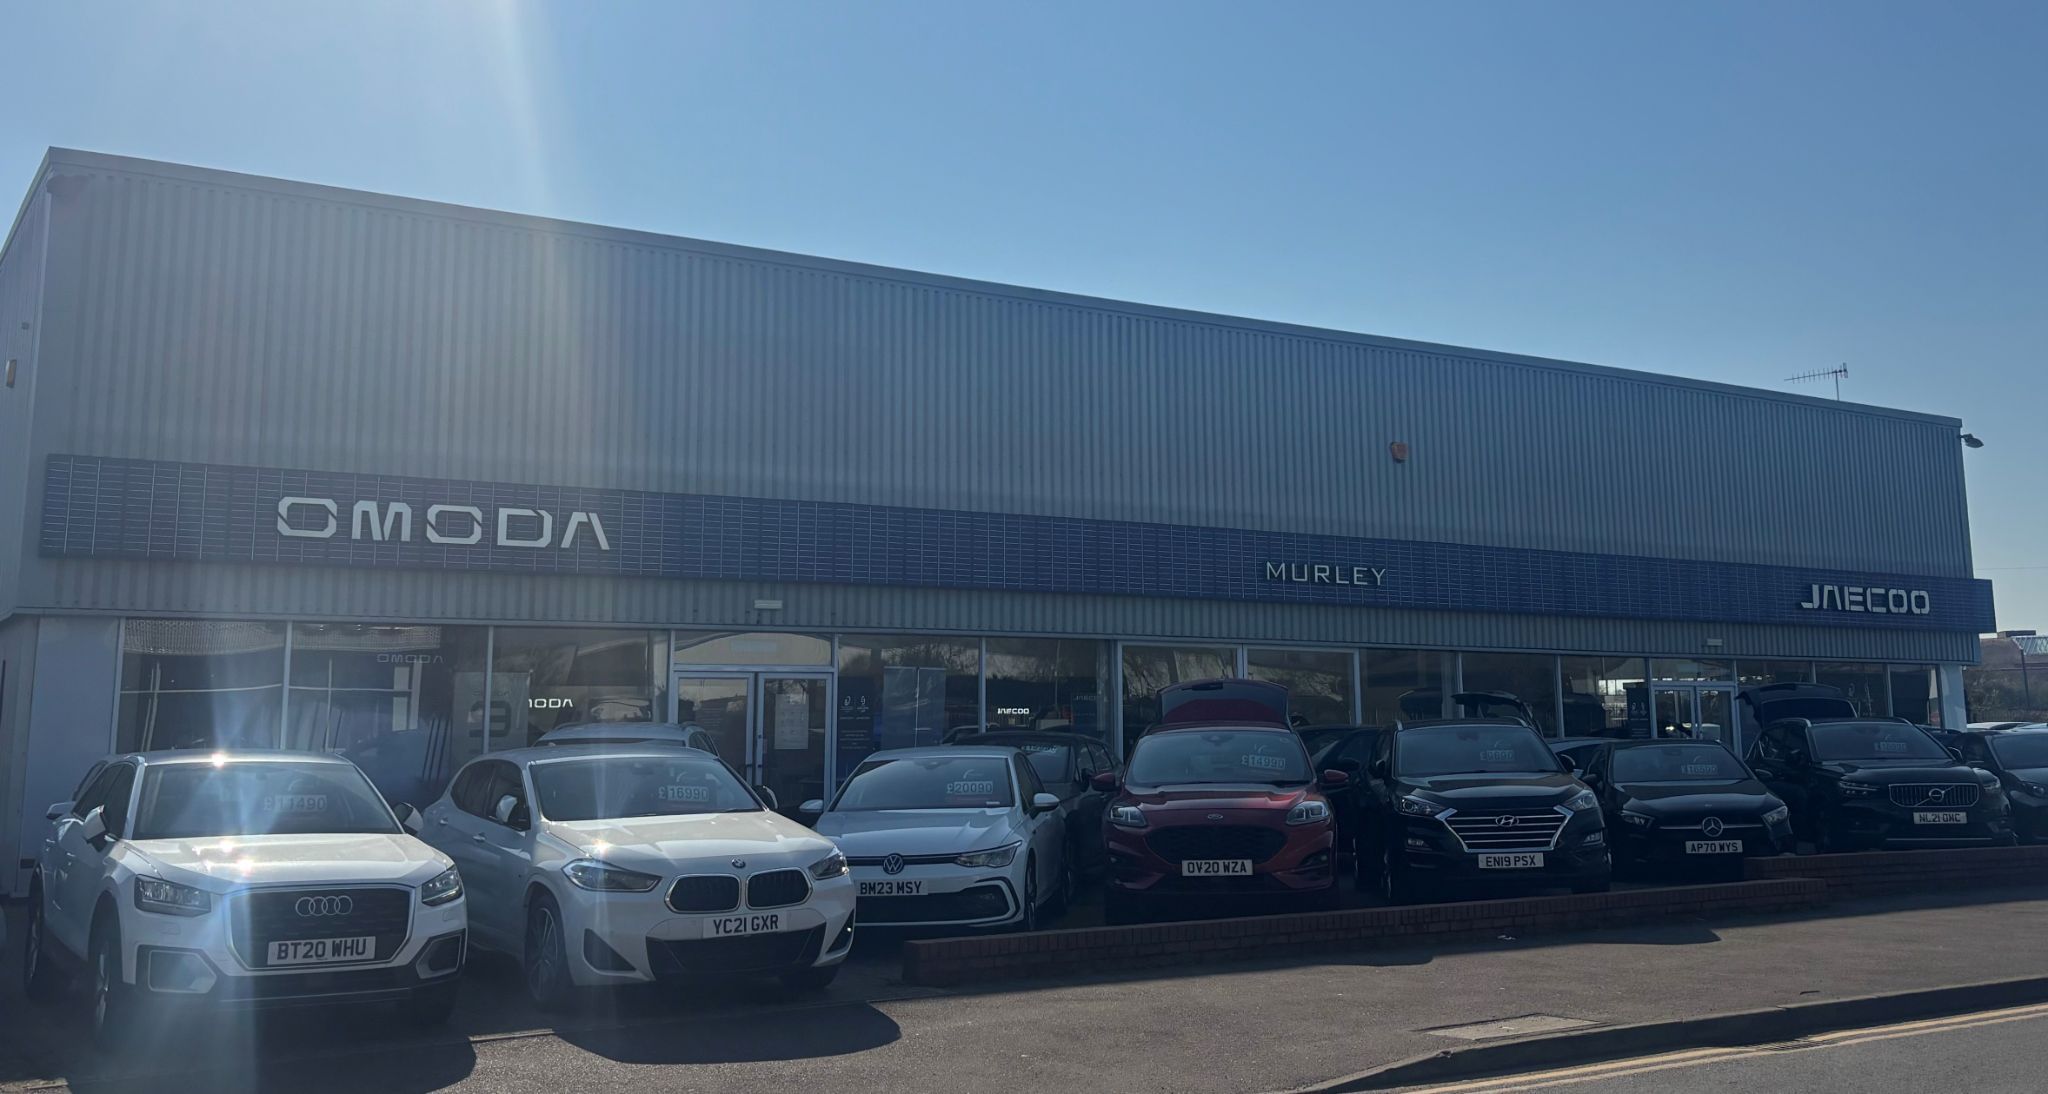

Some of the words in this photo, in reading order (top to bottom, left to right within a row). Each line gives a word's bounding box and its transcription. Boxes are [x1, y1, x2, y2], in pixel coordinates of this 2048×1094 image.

[277, 497, 610, 550] OMODA
[1266, 561, 1386, 586] MURLEY
[1801, 584, 1930, 614] JAECOO
[528, 698, 573, 708] ODA
[1691, 842, 1716, 852] AP70
[1187, 861, 1220, 873] OV20
[1222, 861, 1247, 873] WZA
[1485, 856, 1511, 867] EN19
[1513, 855, 1536, 866] PSX
[860, 882, 893, 895] BM23
[896, 881, 922, 894] MSY
[713, 917, 747, 935] YC21
[751, 914, 779, 932] GXR
[277, 941, 326, 960] BT20
[331, 939, 367, 957] WHU
